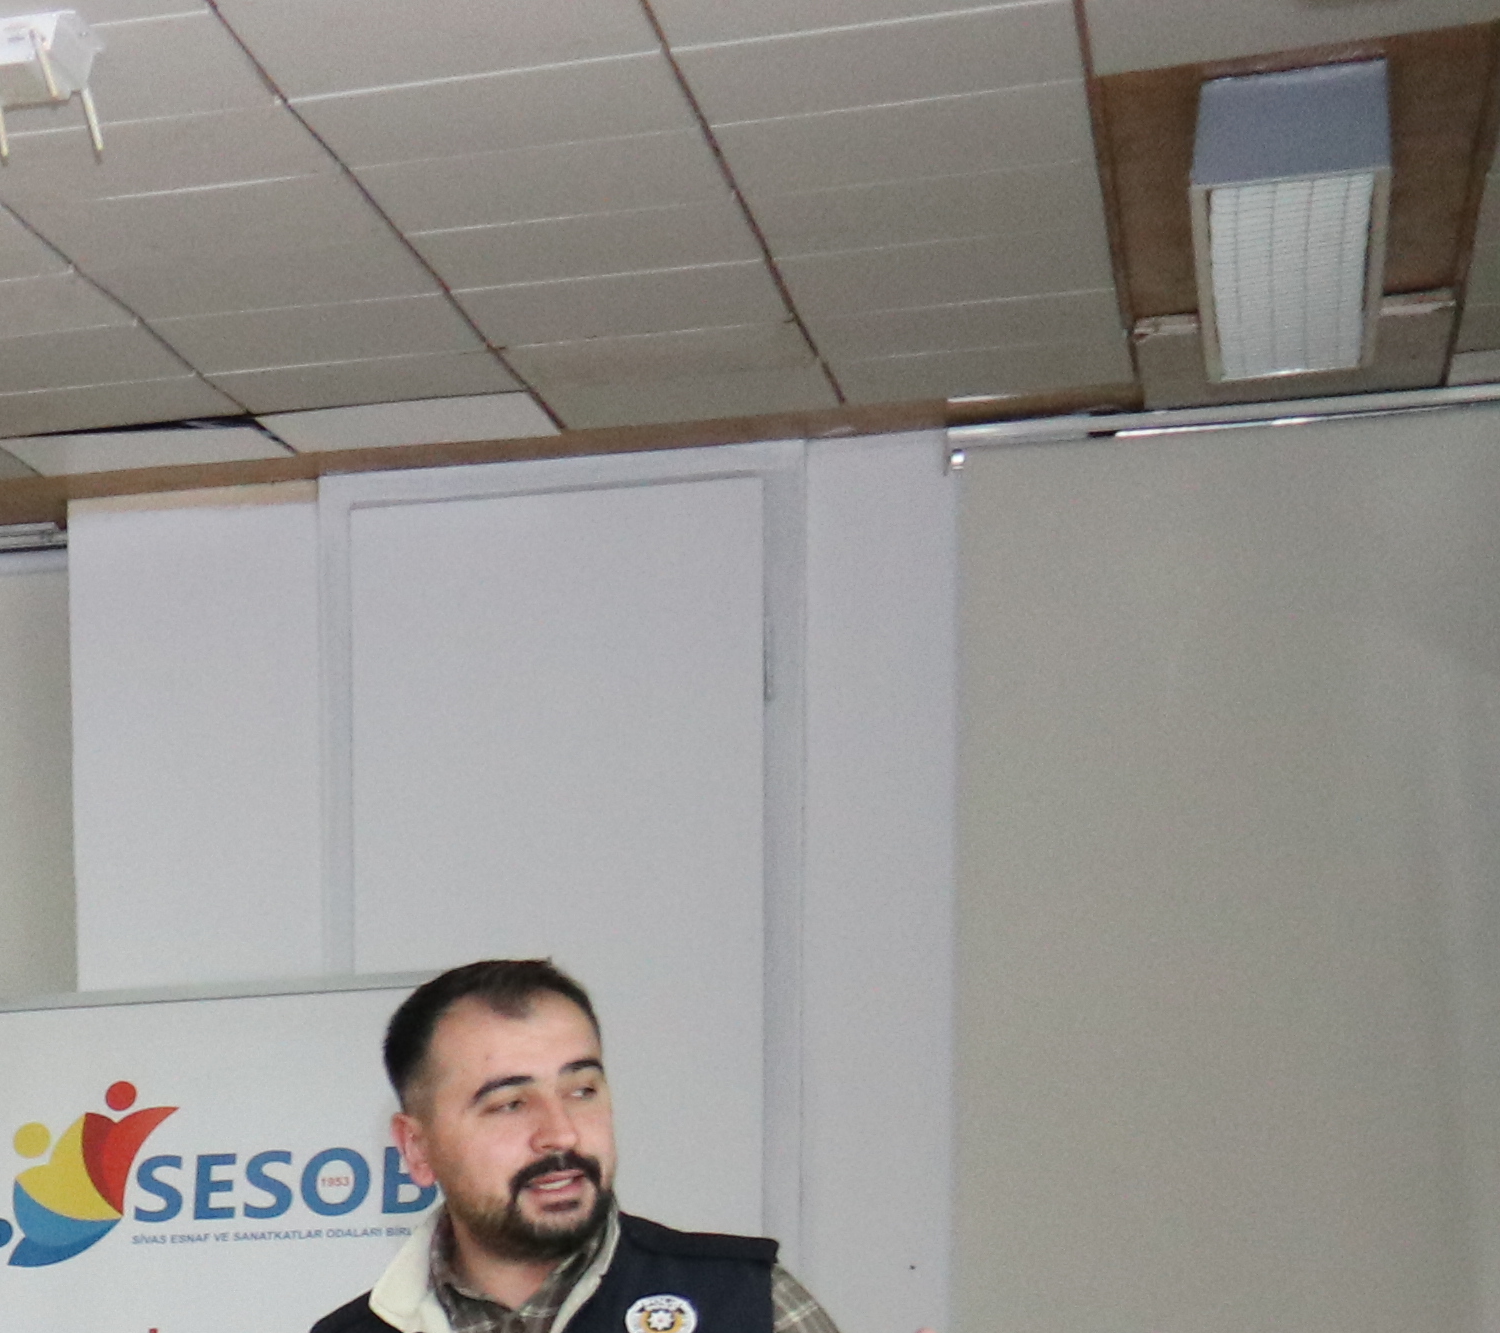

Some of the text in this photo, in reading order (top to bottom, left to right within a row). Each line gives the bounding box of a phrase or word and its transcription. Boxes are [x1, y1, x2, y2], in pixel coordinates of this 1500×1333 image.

[133, 1146, 438, 1224] SESOB
[320, 1176, 351, 1187] 1953
[170, 1232, 210, 1244] ESNAF
[214, 1231, 230, 1242] VE
[326, 1226, 383, 1238] ODALARI
